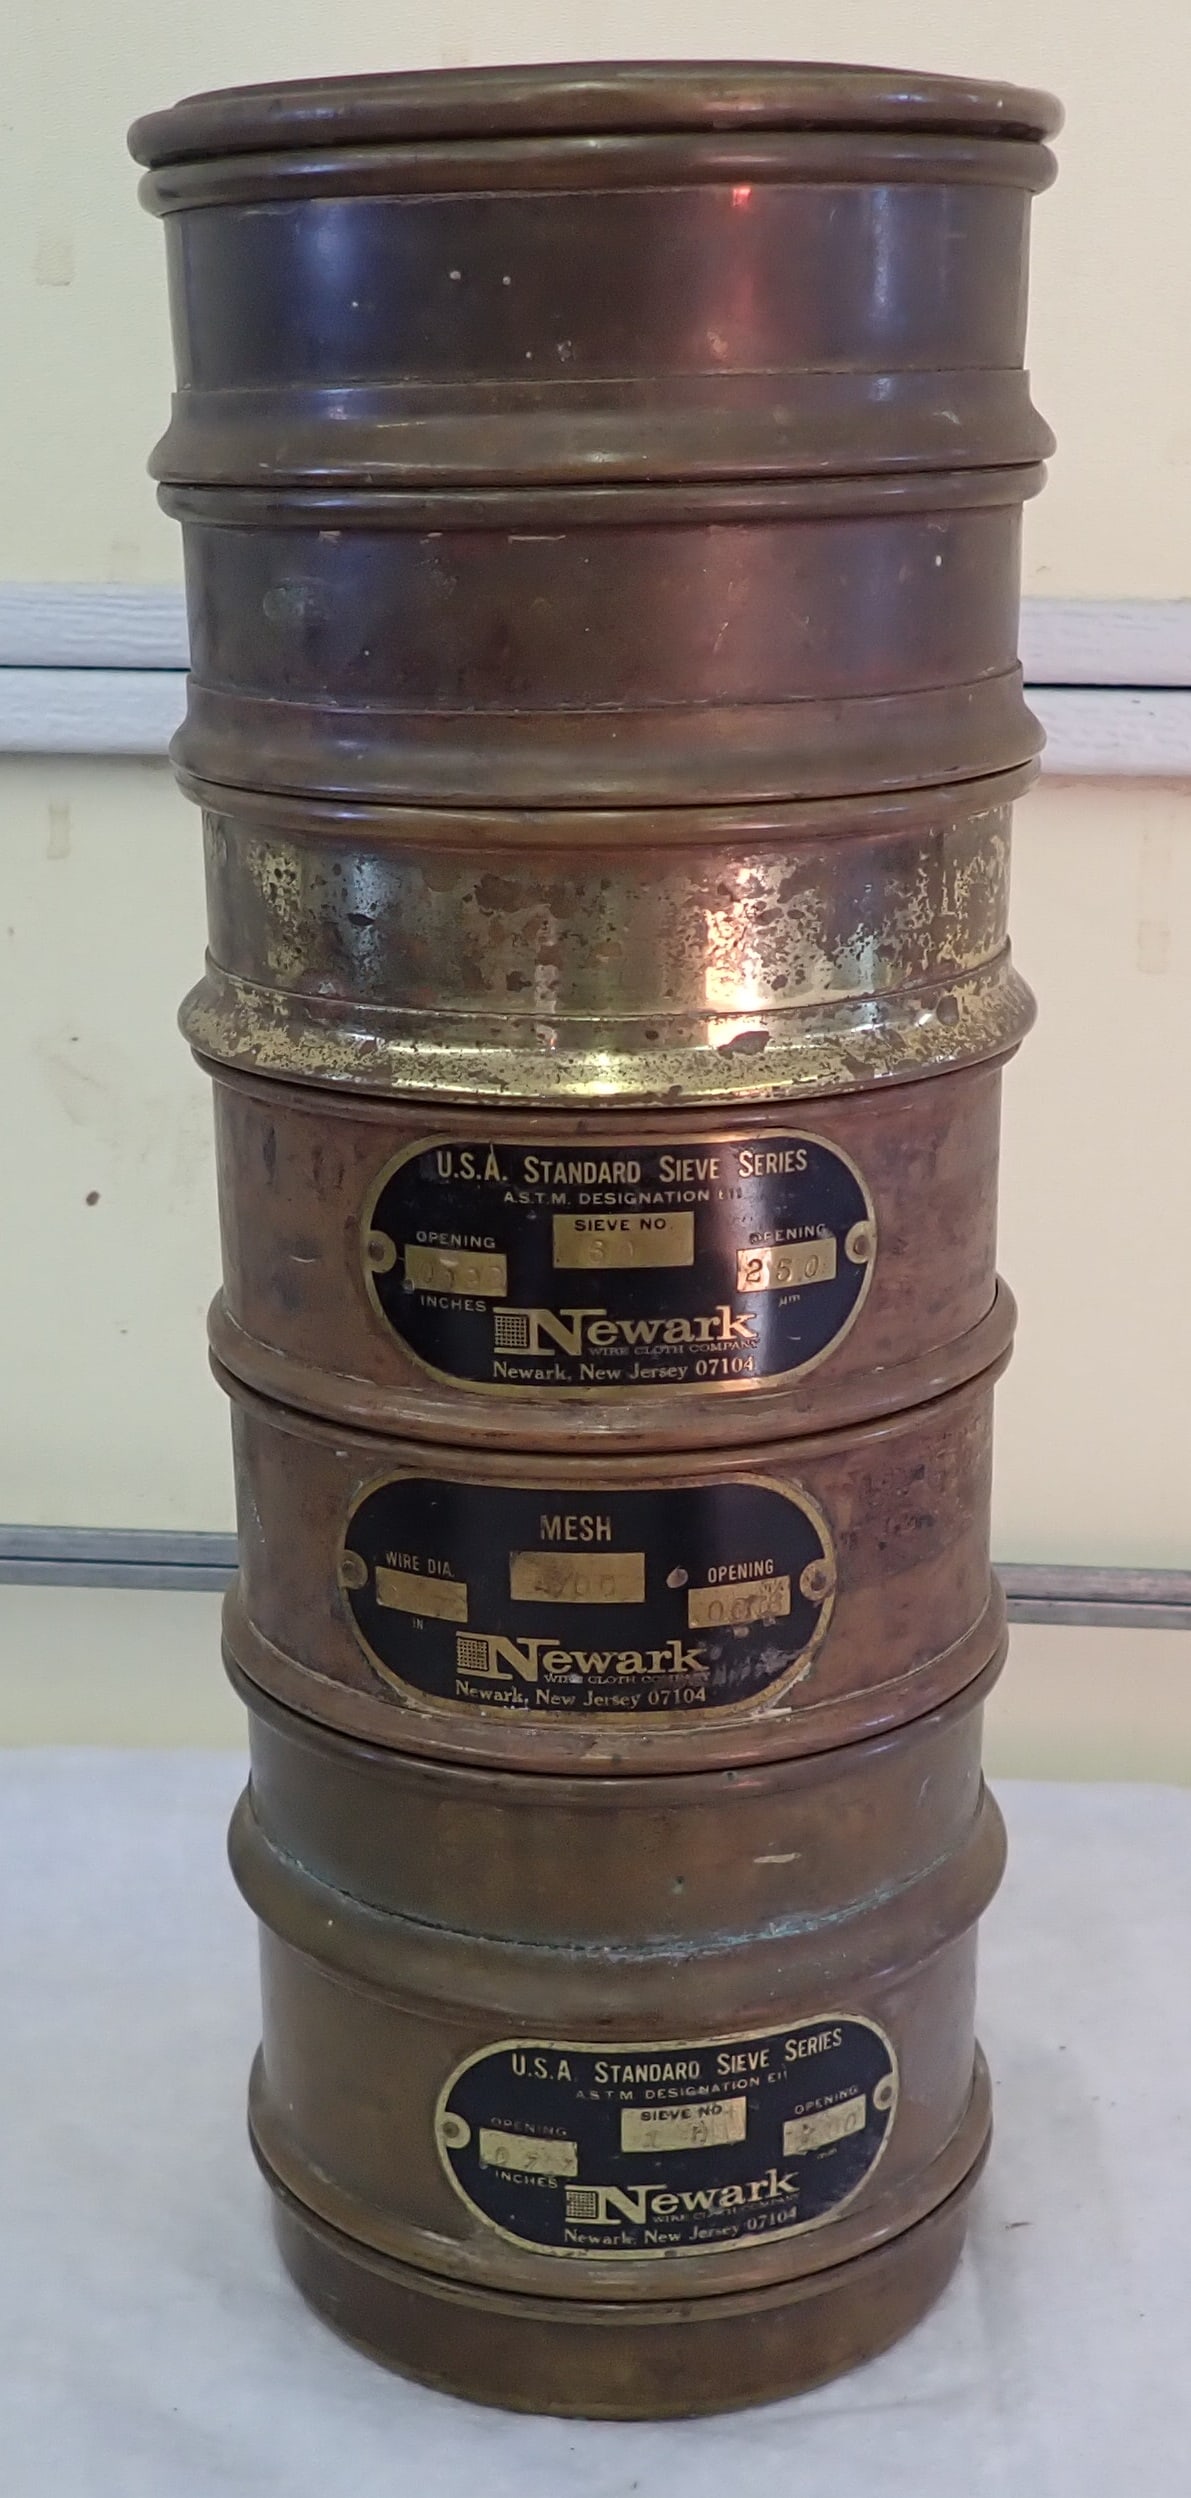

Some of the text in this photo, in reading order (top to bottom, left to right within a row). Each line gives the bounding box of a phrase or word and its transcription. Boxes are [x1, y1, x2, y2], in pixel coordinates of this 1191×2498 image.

[436, 1149, 808, 1185] U.S.A. STANDARD SIEVE SERIES
[579, 1190, 710, 1206] DESIGNATION
[574, 1218, 630, 1232] SIEVE
[416, 1230, 496, 1249] OPENING
[745, 1254, 820, 1283] 250
[420, 1295, 487, 1313] INCHES
[493, 1304, 758, 1356] Newark
[493, 1355, 755, 1382] Newark, New Jersey 07104
[540, 1514, 612, 1541] MESH
[386, 1551, 420, 1572] WIRE
[707, 1559, 775, 1584] OPENING
[455, 1630, 710, 1683] Newark
[535, 1688, 577, 1706] New
[583, 1689, 641, 1709] Jersey
[647, 1686, 707, 1706] 07104
[594, 2060, 700, 2084] STANDARD
[717, 2049, 770, 2076] SIEVE
[784, 2027, 843, 2062] SERIES
[645, 2077, 761, 2100] DESIGNATION
[795, 2084, 858, 2115] OPENING
[640, 2108, 692, 2122] SIEVE
[495, 2169, 558, 2189] INCHES
[565, 2167, 799, 2224] Newark
[643, 2230, 682, 2245] New
[689, 2224, 740, 2242] Jersey
[746, 2205, 798, 2232] 07104
